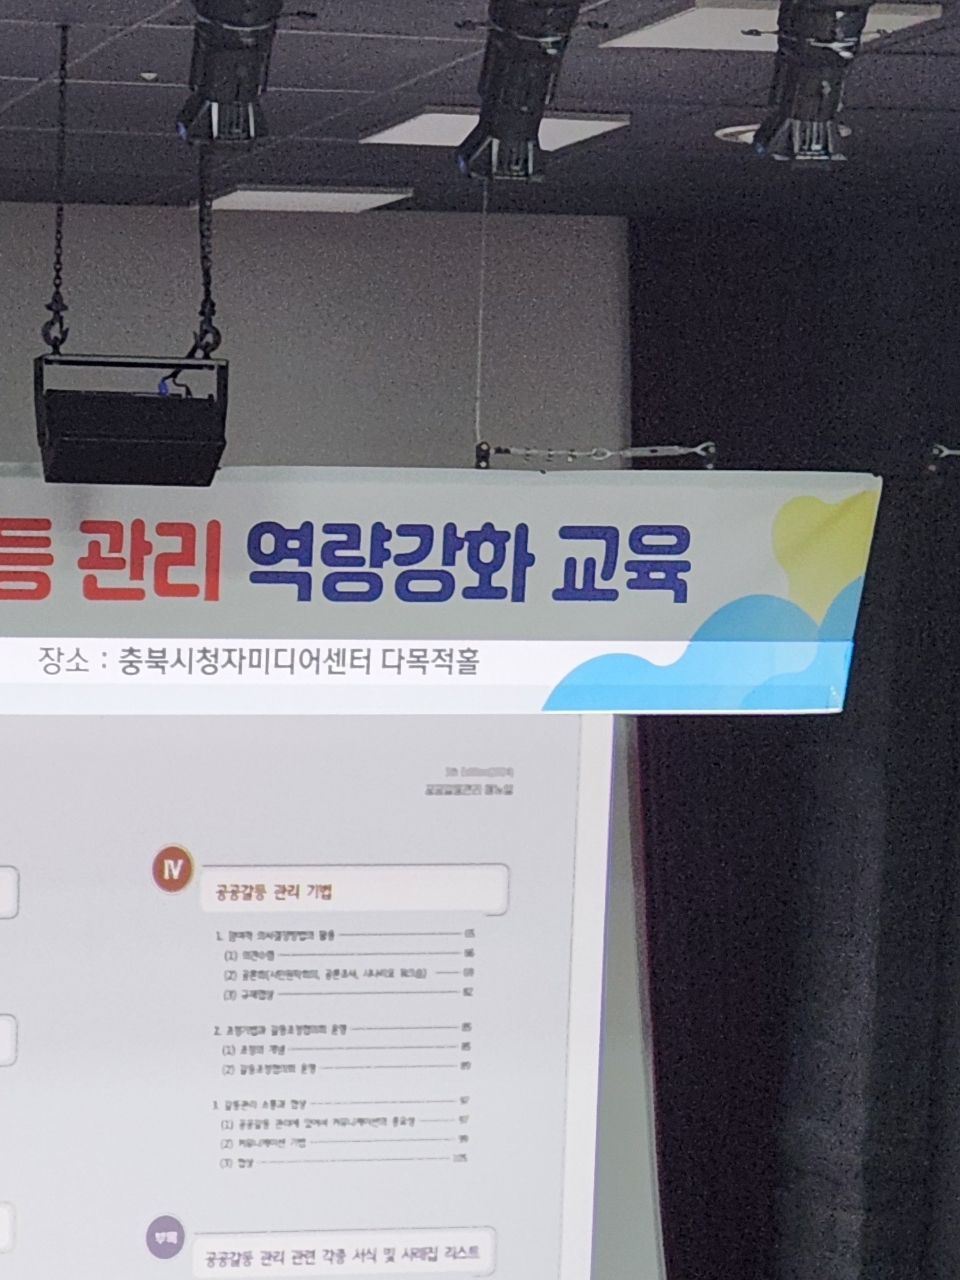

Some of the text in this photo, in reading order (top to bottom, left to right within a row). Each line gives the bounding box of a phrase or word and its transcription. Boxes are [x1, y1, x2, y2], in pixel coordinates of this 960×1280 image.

[78, 518, 220, 602] 관리
[246, 520, 536, 603] 역량강화
[551, 524, 692, 604] 교육
[38, 647, 90, 674] 장소
[118, 646, 371, 676] 충북시청자미디어센터
[381, 647, 480, 677] 다목적홀
[274, 884, 300, 901] 관리
[260, 1250, 285, 1266] 관리
